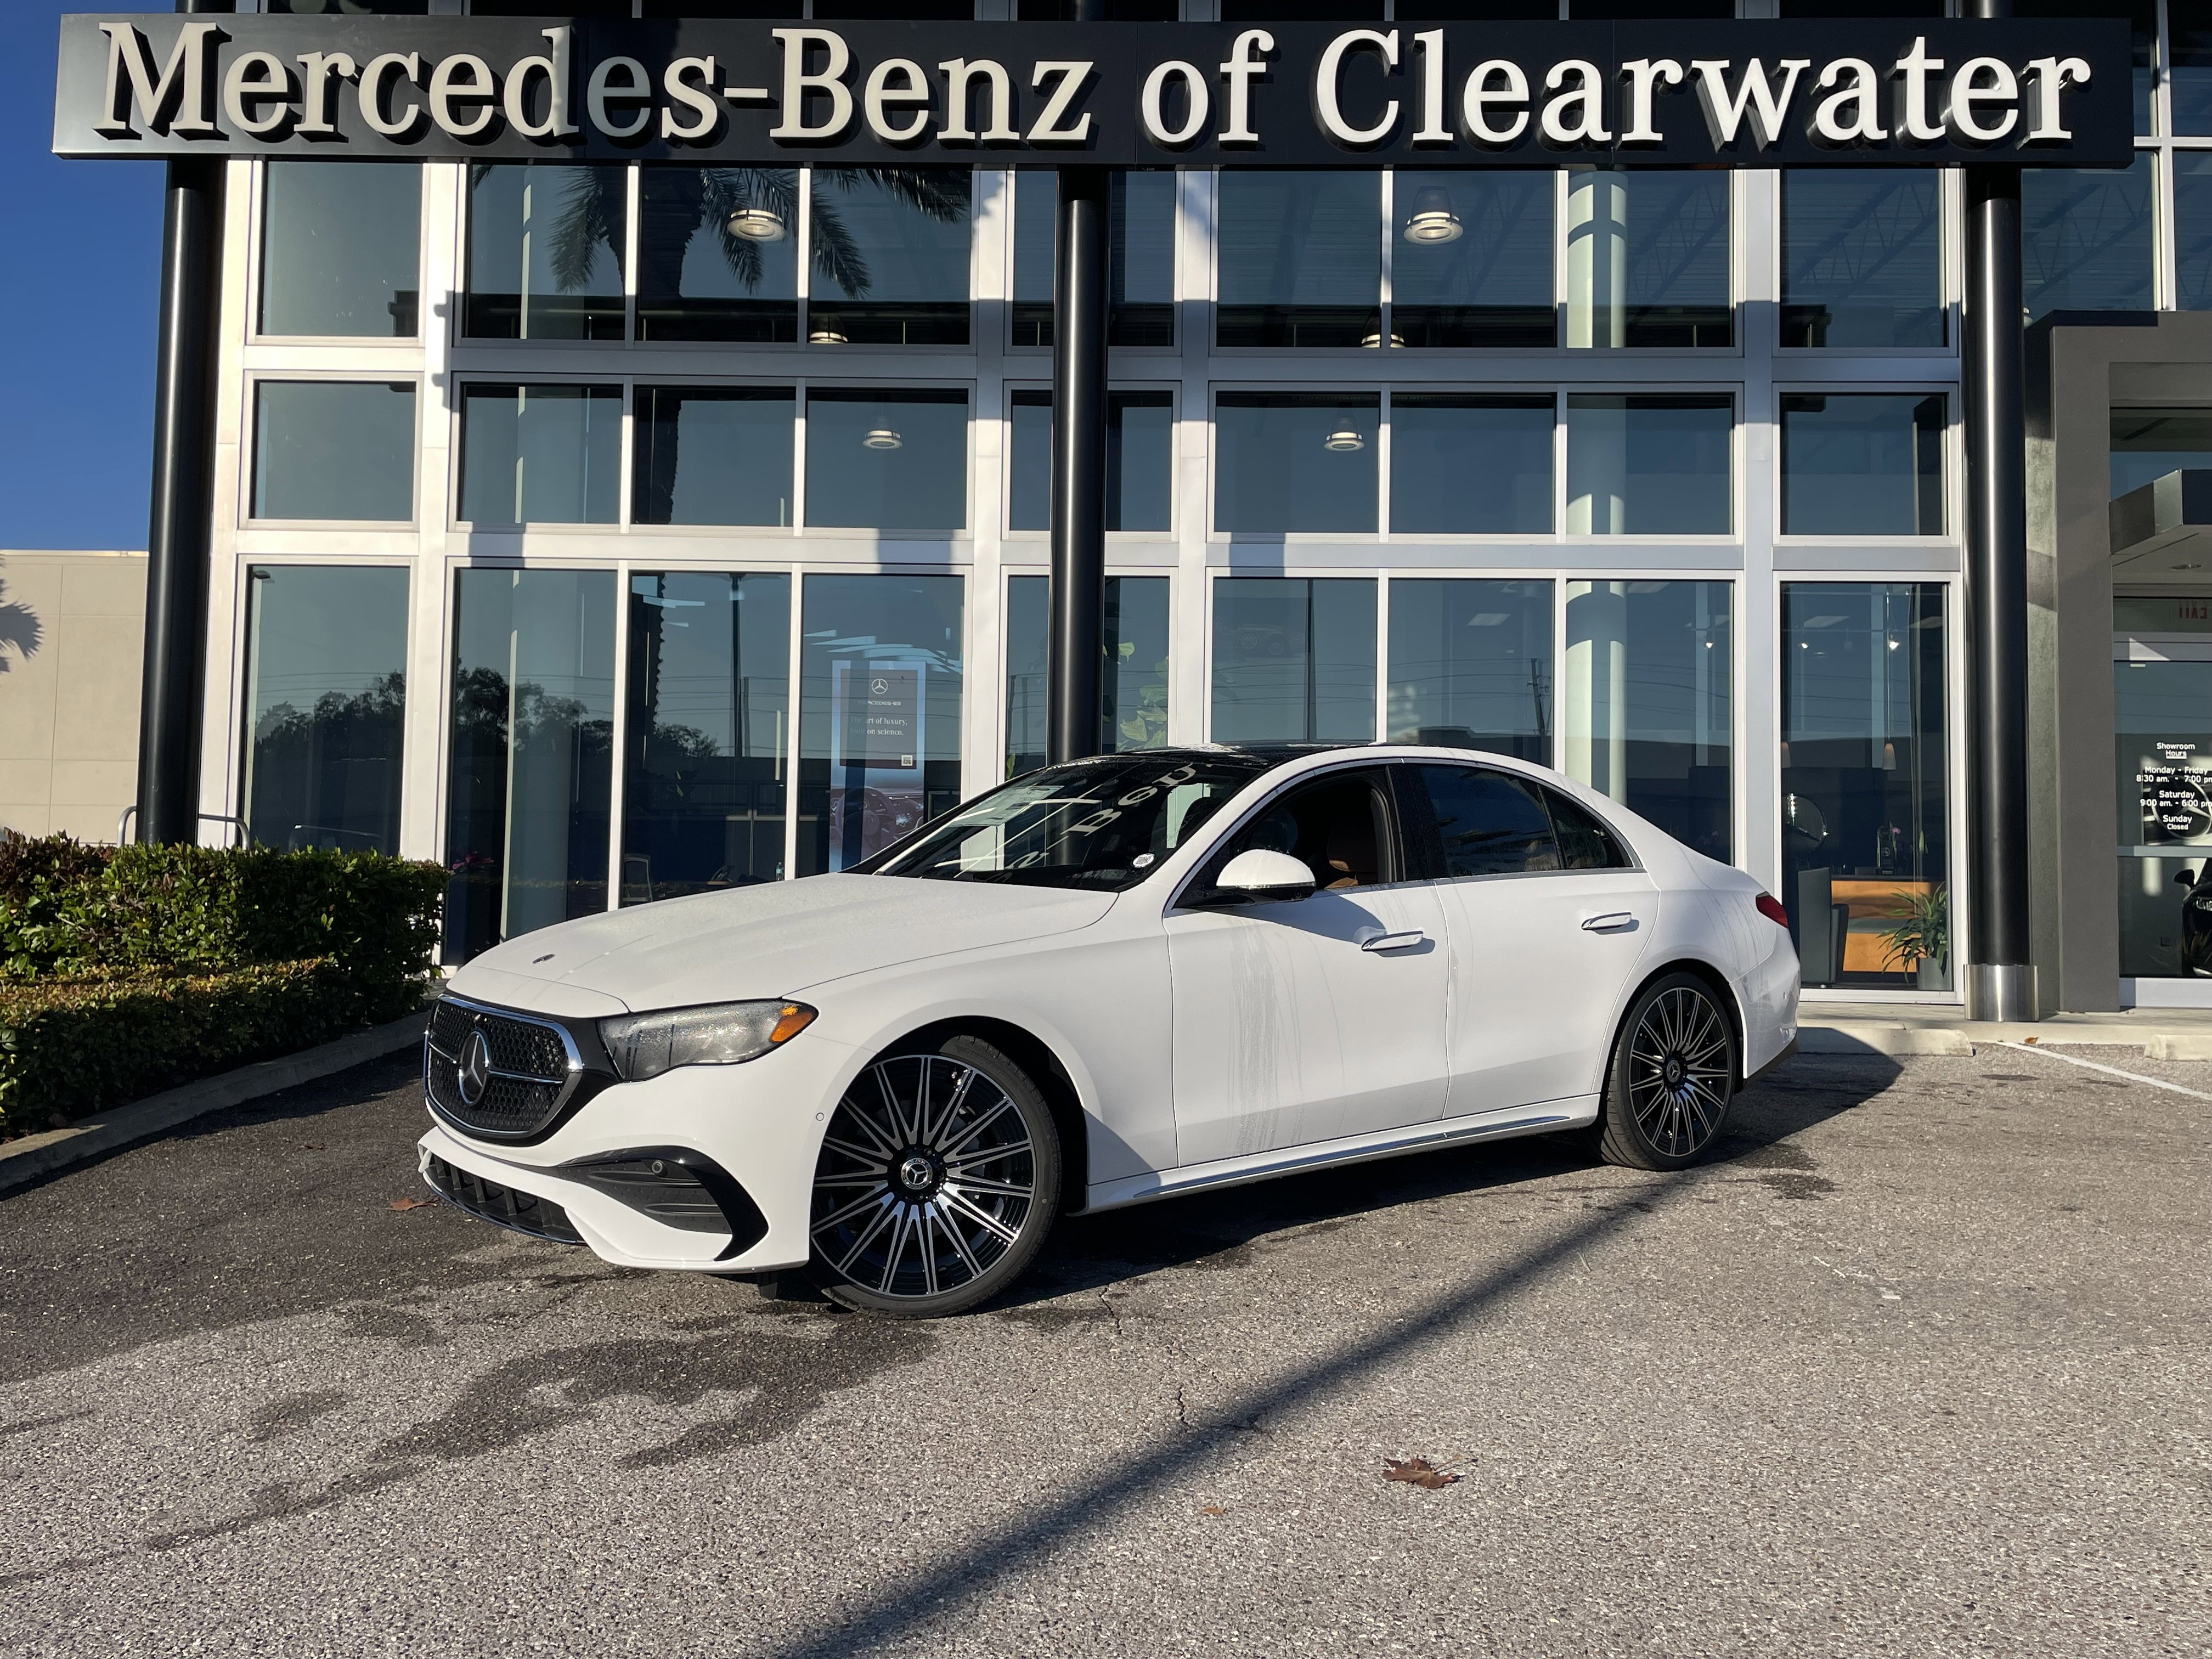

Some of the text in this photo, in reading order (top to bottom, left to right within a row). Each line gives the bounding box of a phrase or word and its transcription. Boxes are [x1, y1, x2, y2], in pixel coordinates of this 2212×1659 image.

[91, 21, 2091, 145] Mercedes-Benz of Clearwater
[884, 718, 907, 726] luxury,
[2145, 766, 2176, 775] Monday
[2185, 766, 2208, 775] Friday
[2159, 790, 2195, 799] Saturday
[2163, 815, 2192, 823] Sunday
